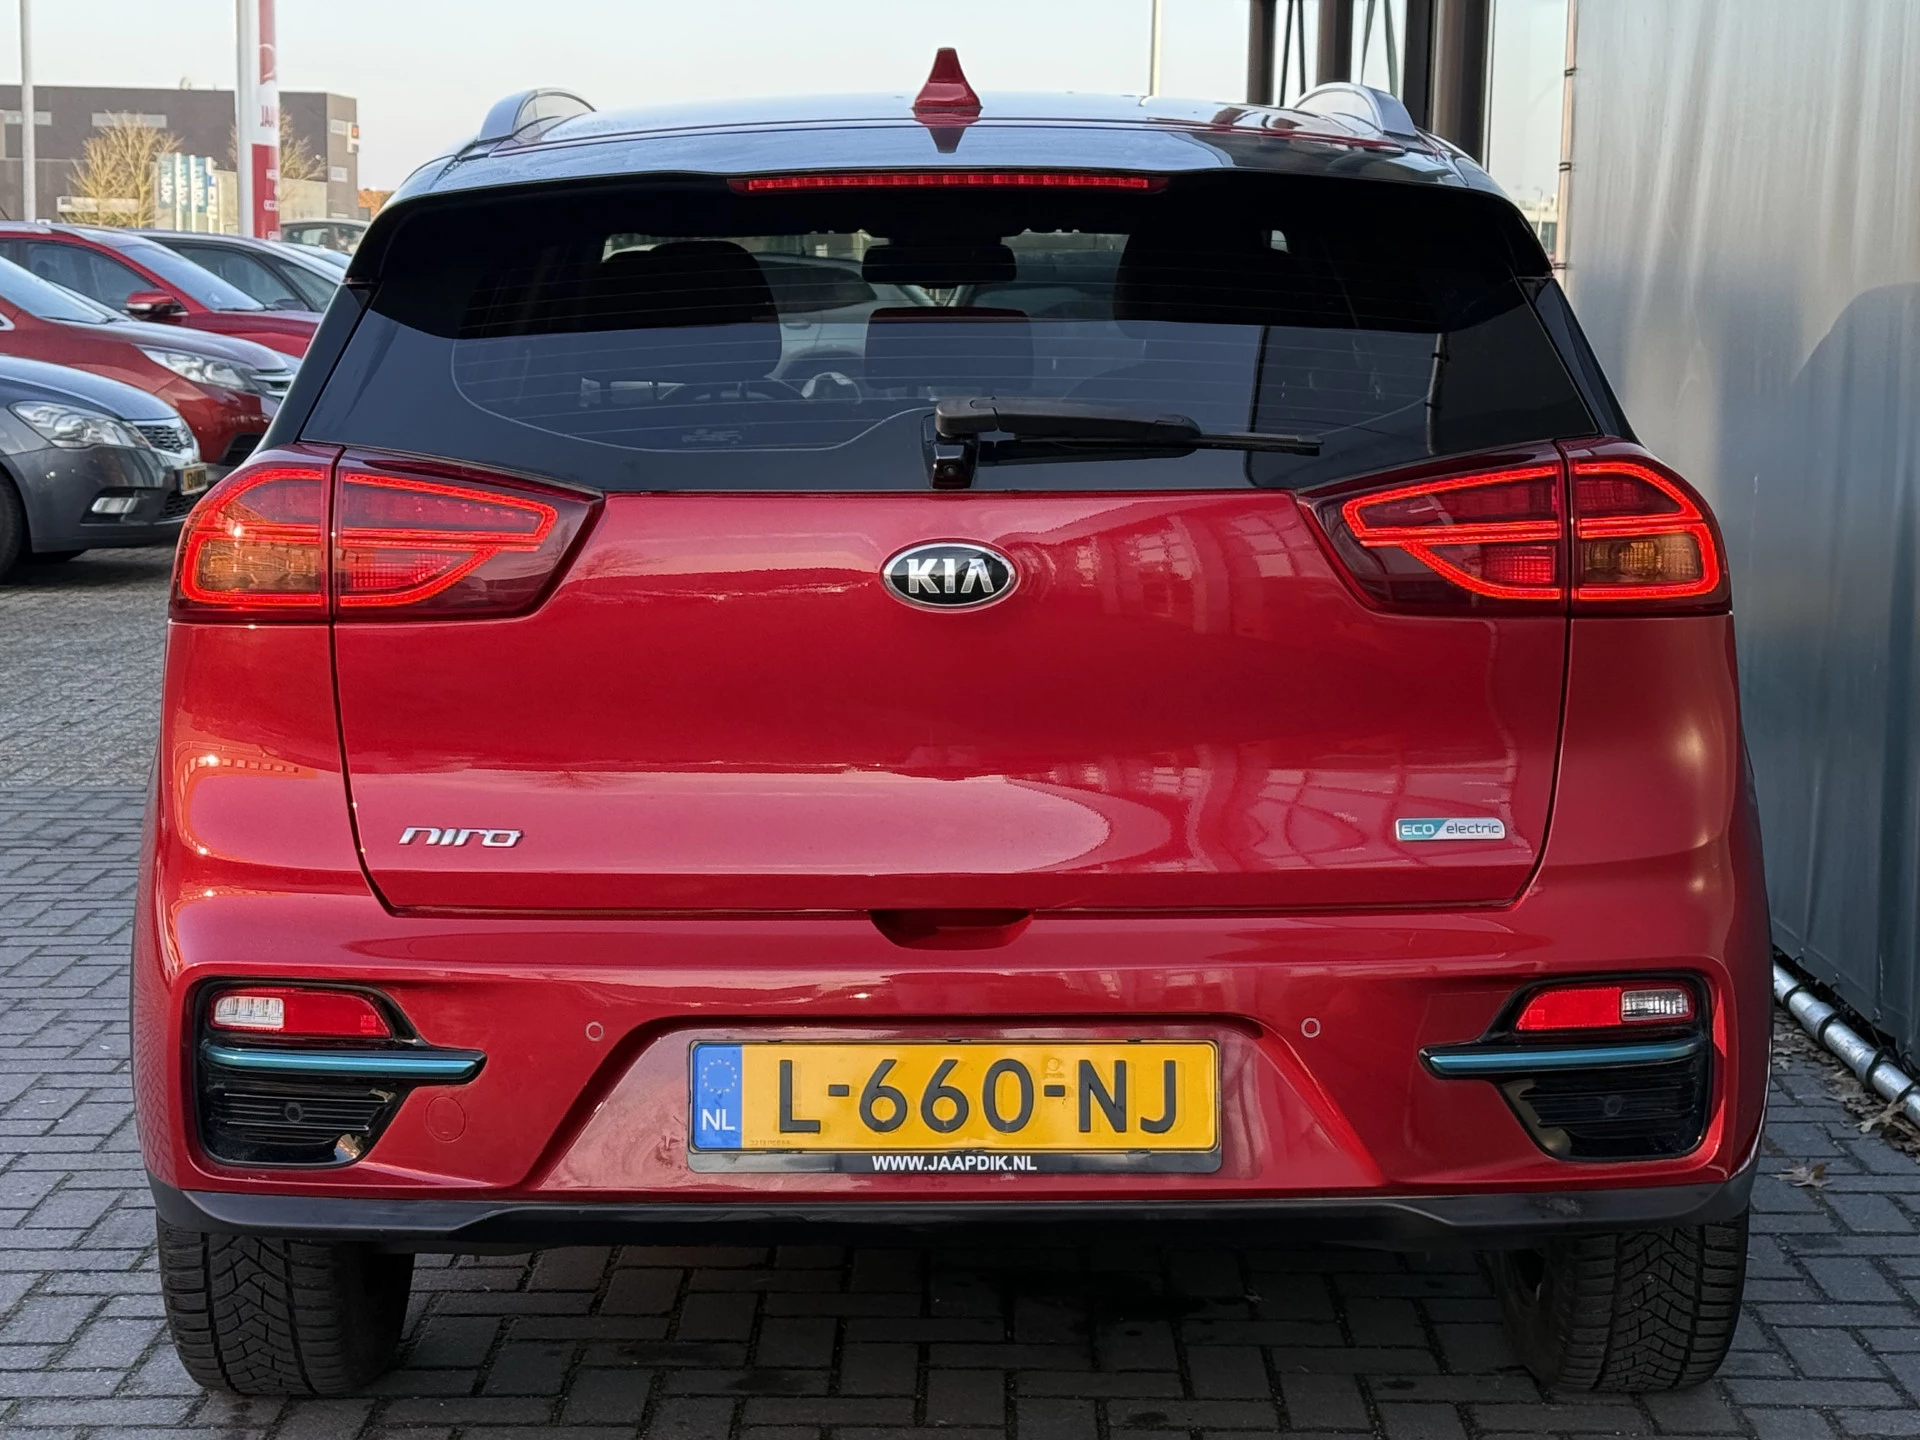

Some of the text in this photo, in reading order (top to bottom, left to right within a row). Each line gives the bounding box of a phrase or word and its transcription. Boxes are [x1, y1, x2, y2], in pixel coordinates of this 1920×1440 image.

[906, 558, 994, 594] KIA
[1401, 822, 1500, 836] ECO electric
[779, 1058, 1176, 1134] L-660-NJ
[701, 1108, 736, 1131] NL
[872, 1155, 1038, 1171] WWW.JAAPDIK.NL
